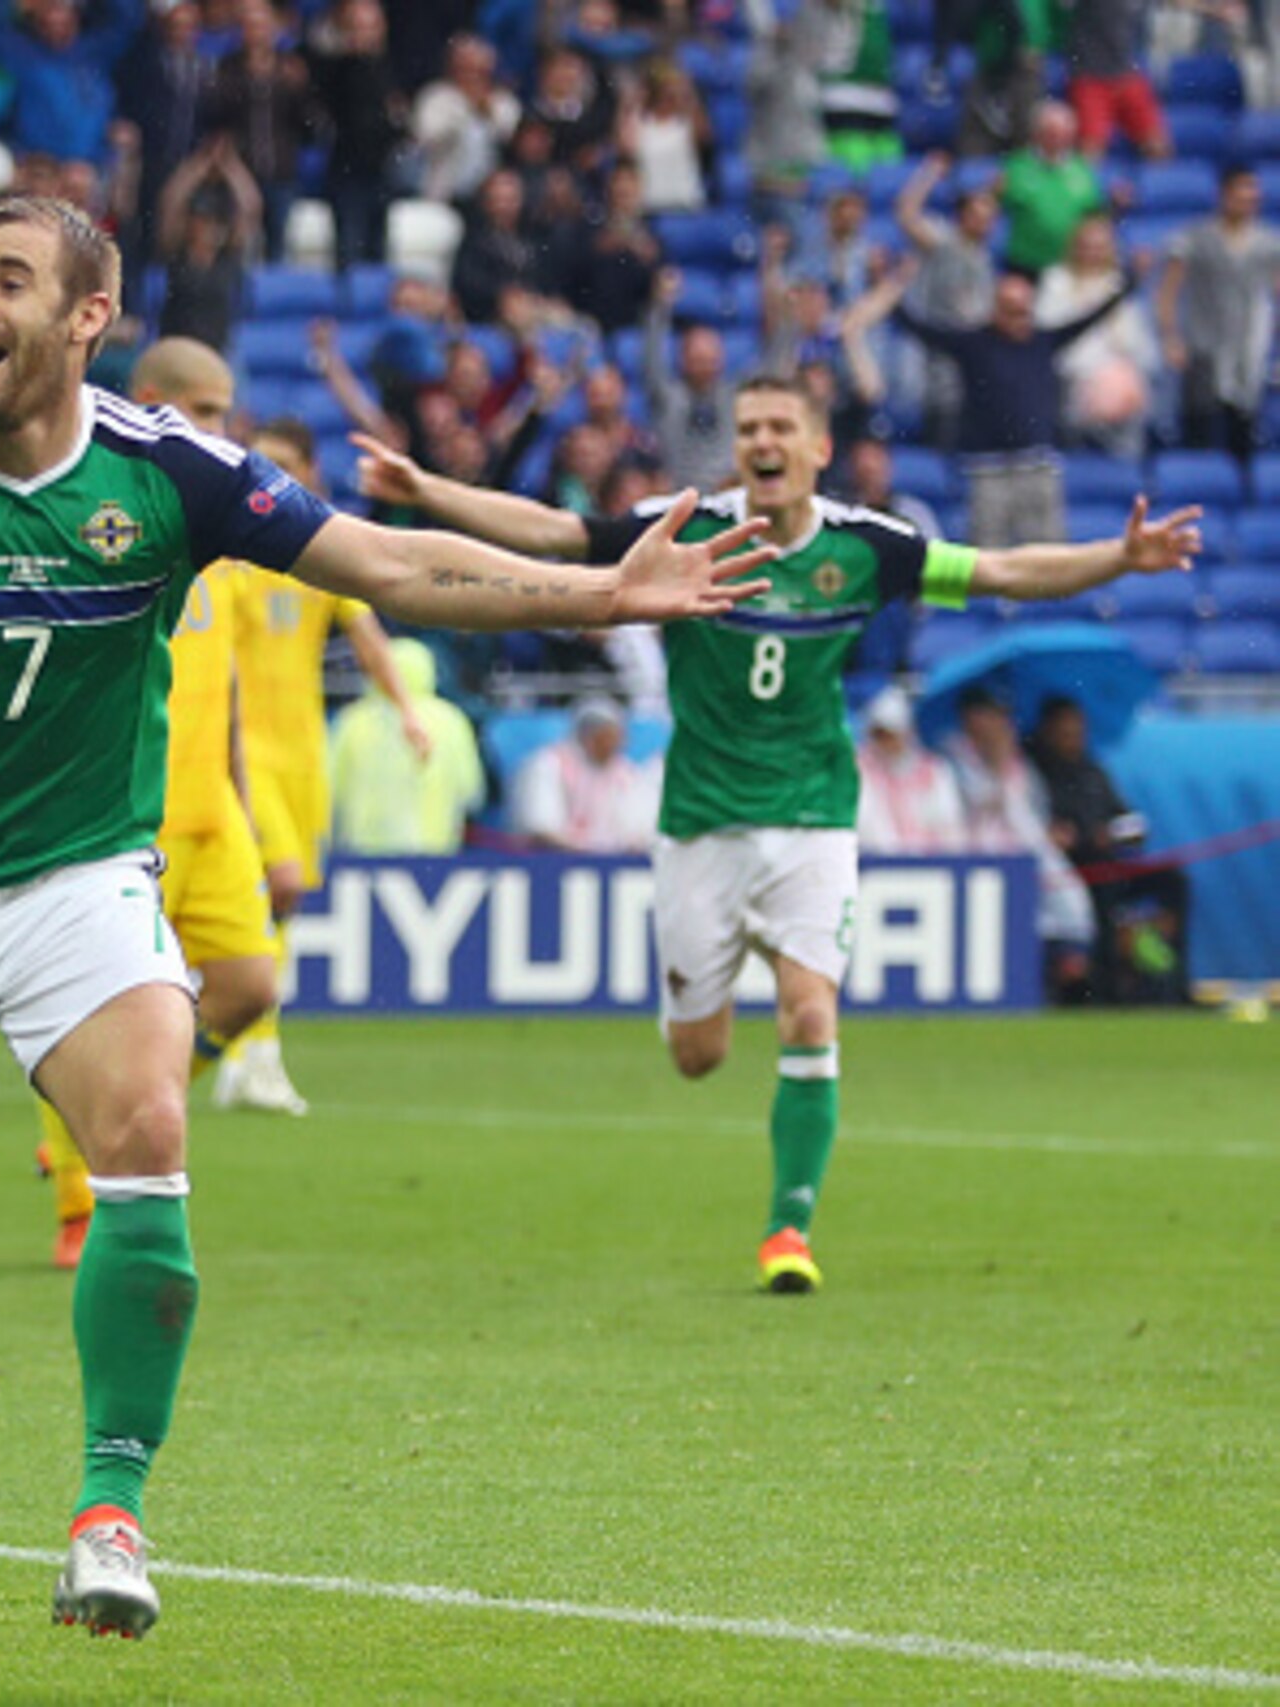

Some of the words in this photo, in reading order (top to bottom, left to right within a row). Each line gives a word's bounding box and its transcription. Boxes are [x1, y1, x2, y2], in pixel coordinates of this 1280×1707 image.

[3, 627, 53, 720] 7
[749, 634, 785, 700] 8
[282, 869, 1004, 1005] HYUAI
